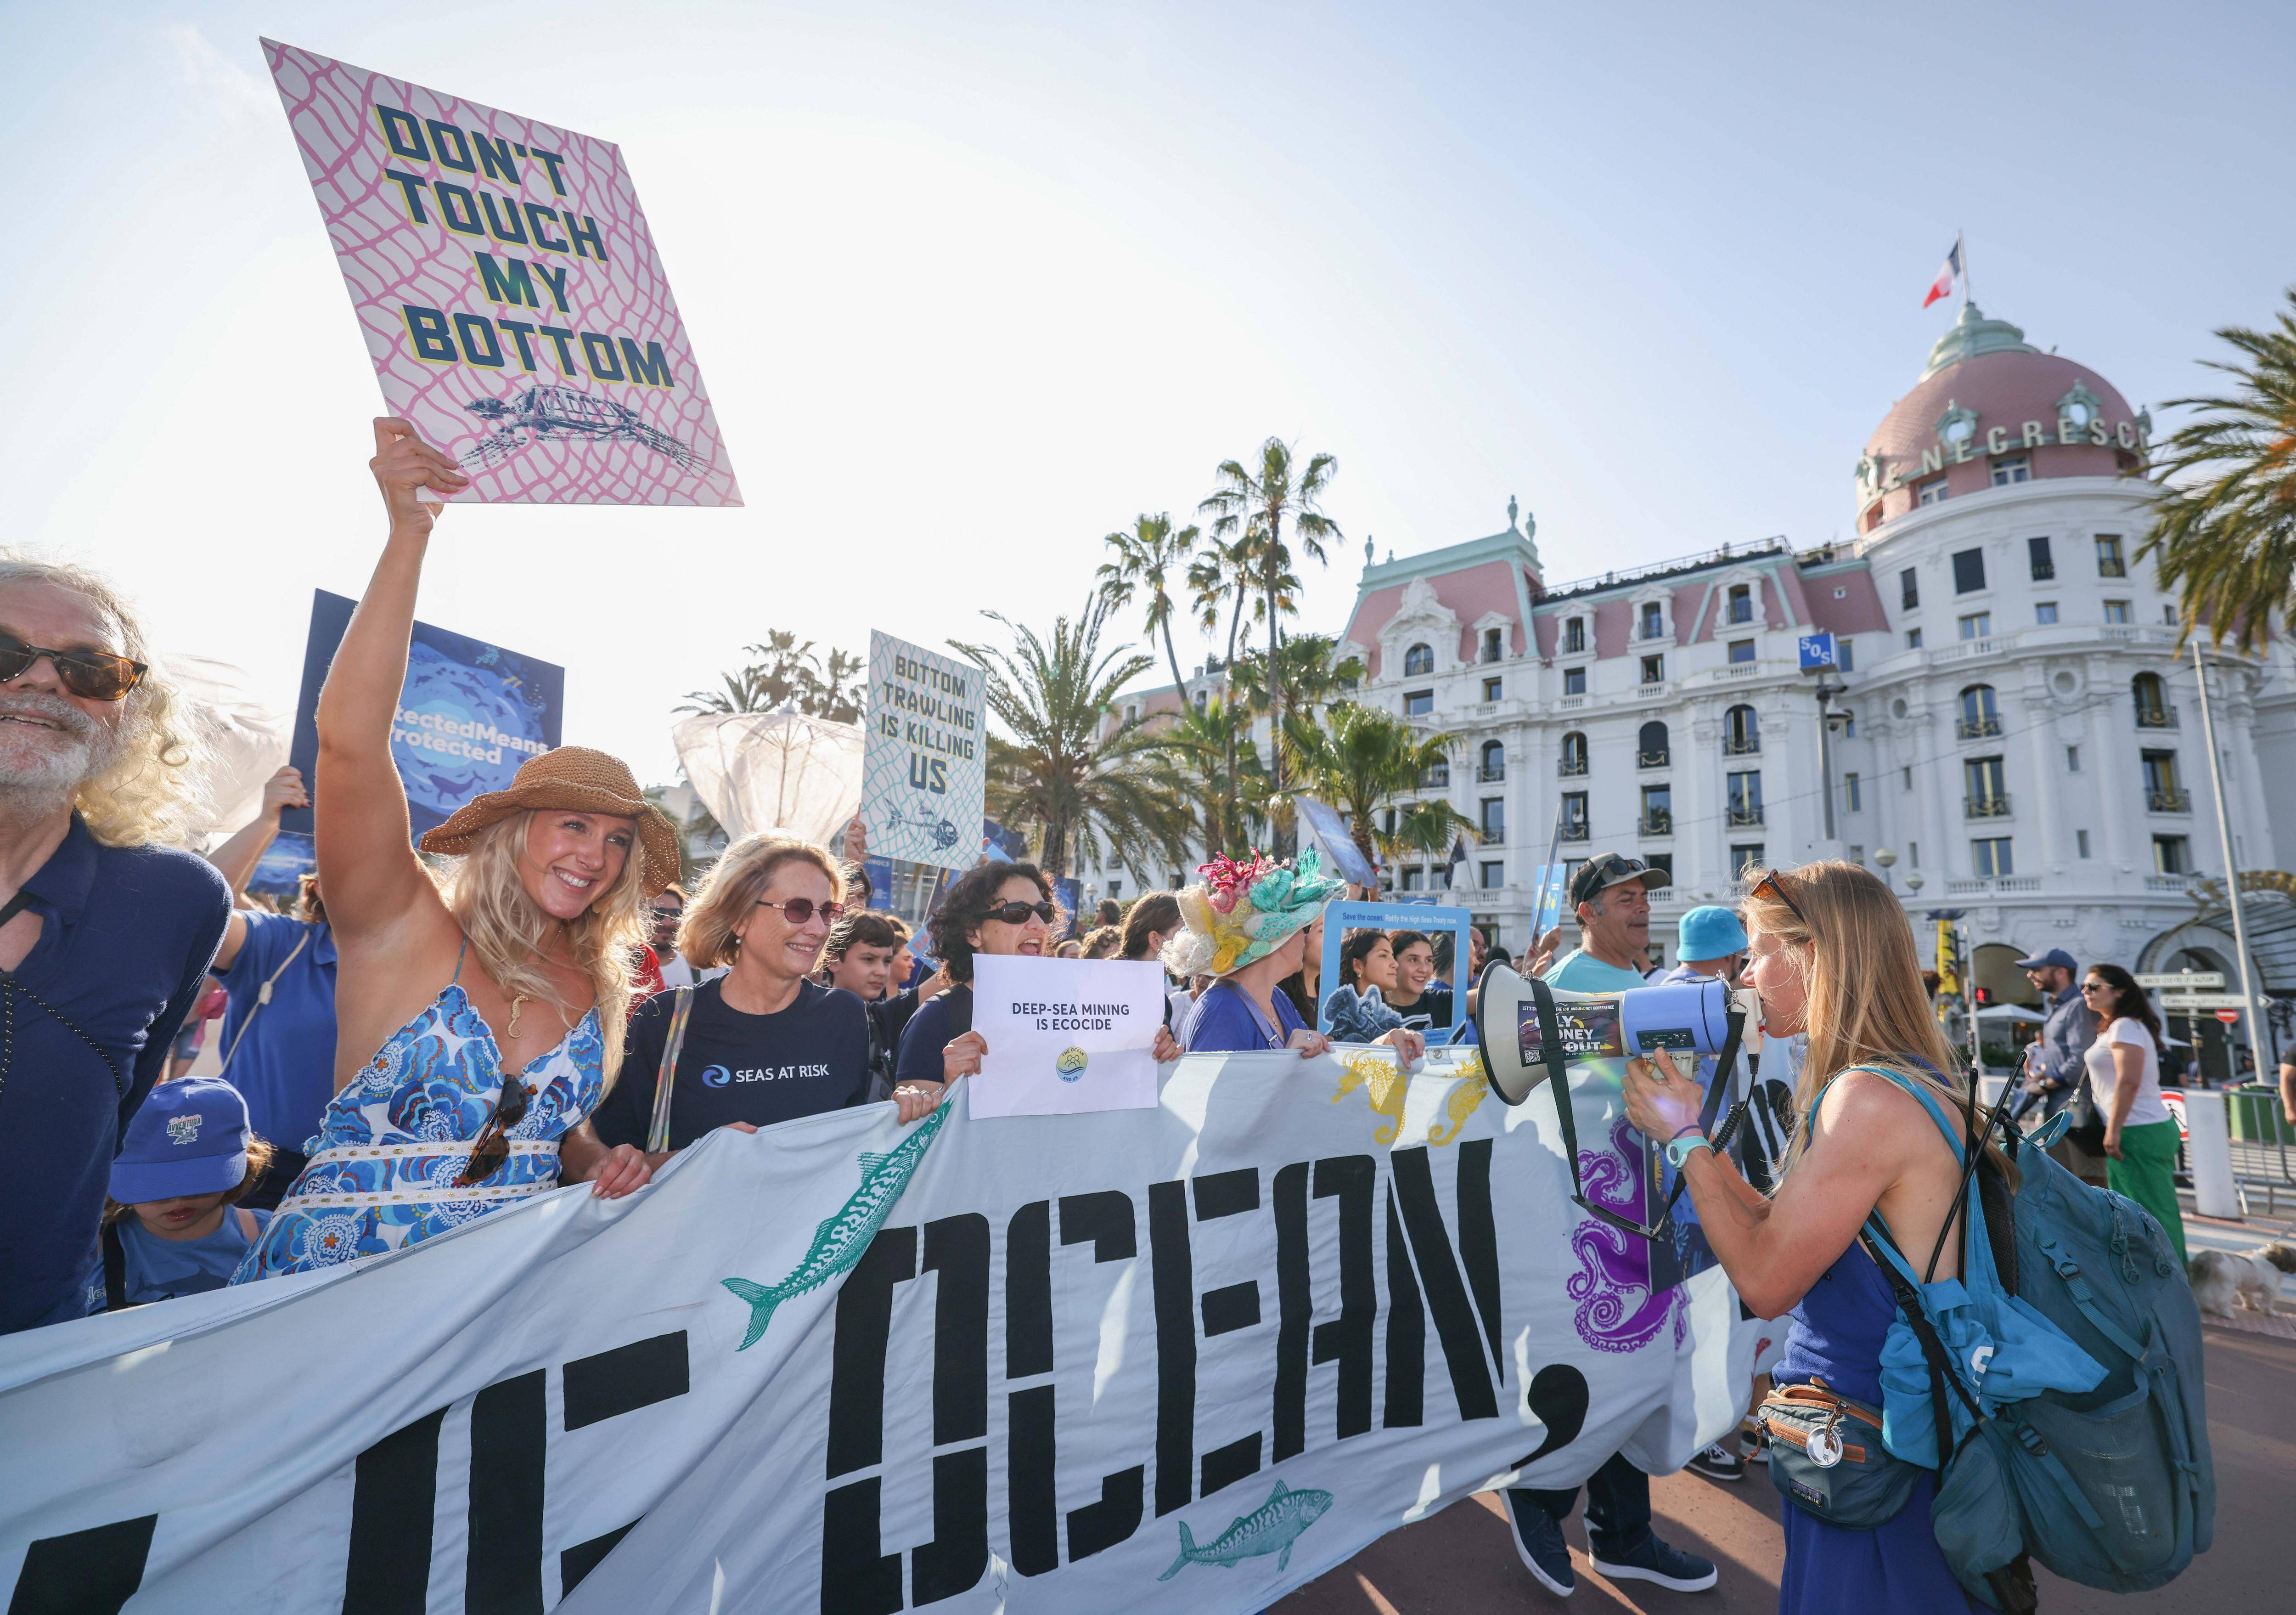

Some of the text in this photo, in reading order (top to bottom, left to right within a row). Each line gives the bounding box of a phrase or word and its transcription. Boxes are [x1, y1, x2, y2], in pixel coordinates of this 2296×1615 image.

[376, 104, 568, 197] DON'T
[385, 168, 608, 262] TOUCH
[471, 251, 570, 315] MY
[400, 304, 675, 391] BOTTOM
[1801, 637, 1831, 664] SOS
[895, 655, 965, 698] BOTTOM
[883, 682, 974, 731] TRAWLING
[395, 705, 549, 755] tectedMeans
[881, 713, 974, 760] IS KILLING
[910, 752, 947, 795] US
[1385, 914, 1400, 923] Ratify
[1409, 915, 1420, 924] High
[1433, 917, 1446, 925] Treaty
[1012, 1003, 1129, 1016] DEEP-SEA MINING
[1036, 1018, 1111, 1030] IS ECOCIDE
[1070, 1048, 1085, 1056] OCEAN
[1540, 1029, 1594, 1040] NEY
[1566, 1041, 1601, 1052] OUT
[736, 1064, 829, 1082] SEAS AT RISK
